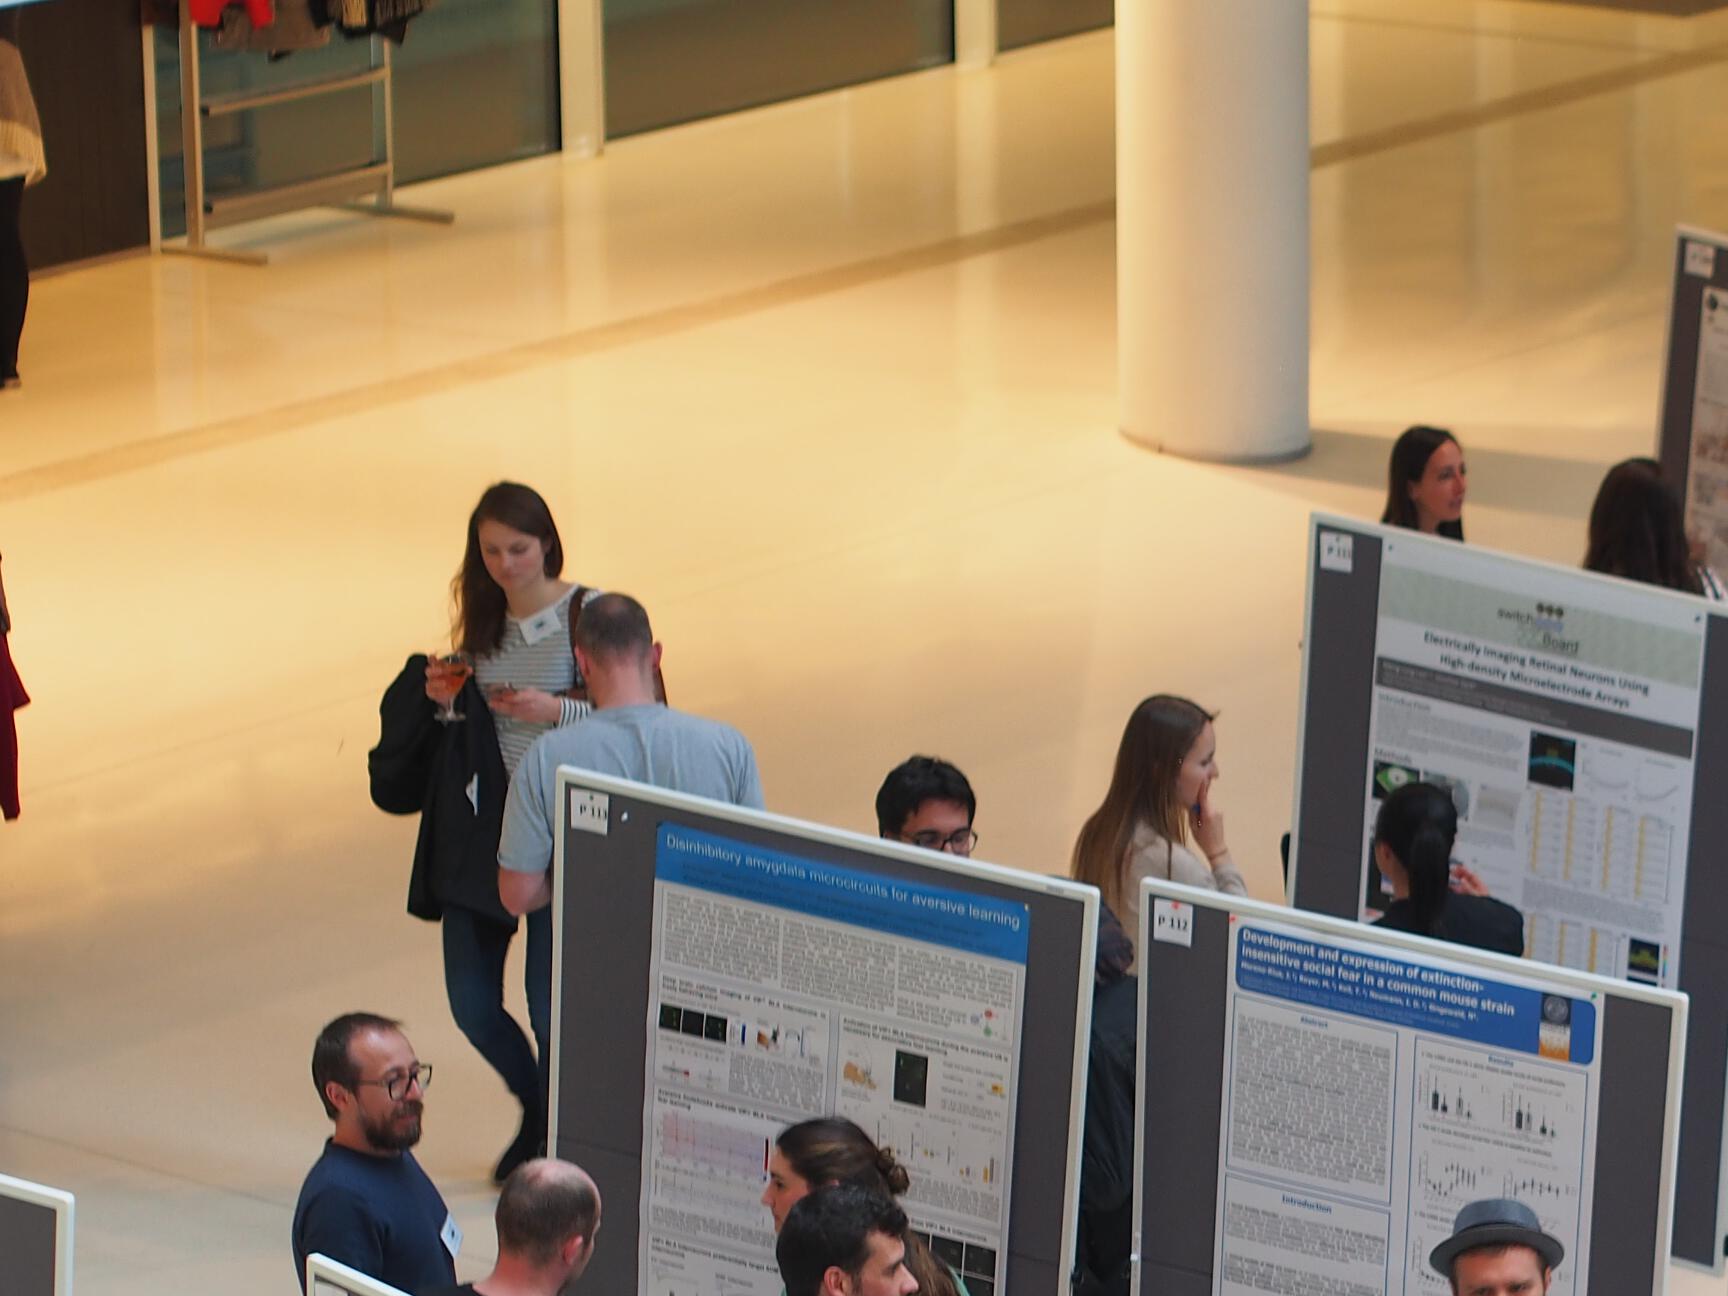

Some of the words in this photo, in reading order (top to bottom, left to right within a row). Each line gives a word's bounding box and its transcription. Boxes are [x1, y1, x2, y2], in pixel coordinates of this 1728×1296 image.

[1424, 630, 1480, 655] Electrically
[1529, 656, 1566, 675] Retinal
[1570, 666, 1615, 687] Neurons
[1619, 677, 1649, 696] Using
[1440, 654, 1507, 680] High-density
[1510, 671, 1592, 699] Microelectrode
[1595, 690, 1630, 708] Arrays
[667, 833, 742, 867] Disinhibitory
[746, 855, 806, 878] amygdala
[809, 869, 888, 899] microcircuits
[891, 886, 908, 902] for
[912, 894, 965, 917] aversive
[969, 903, 1020, 932] learning
[1158, 914, 1165, 927] P
[1170, 916, 1188, 932] 112
[1242, 945, 1300, 969] insensitive
[1303, 959, 1335, 977] social
[1338, 966, 1361, 982] fear
[1363, 971, 1374, 986] in
[1377, 977, 1385, 988] a
[1387, 978, 1437, 999] common
[1439, 989, 1478, 1009] mouse
[1481, 998, 1515, 1017] strain
[1243, 928, 1315, 958] Development
[1318, 946, 1339, 963] and
[1341, 952, 1404, 977] expression
[1406, 964, 1419, 979] of
[1421, 969, 1485, 993] extinction-
[1281, 1194, 1333, 1214] Introduction
